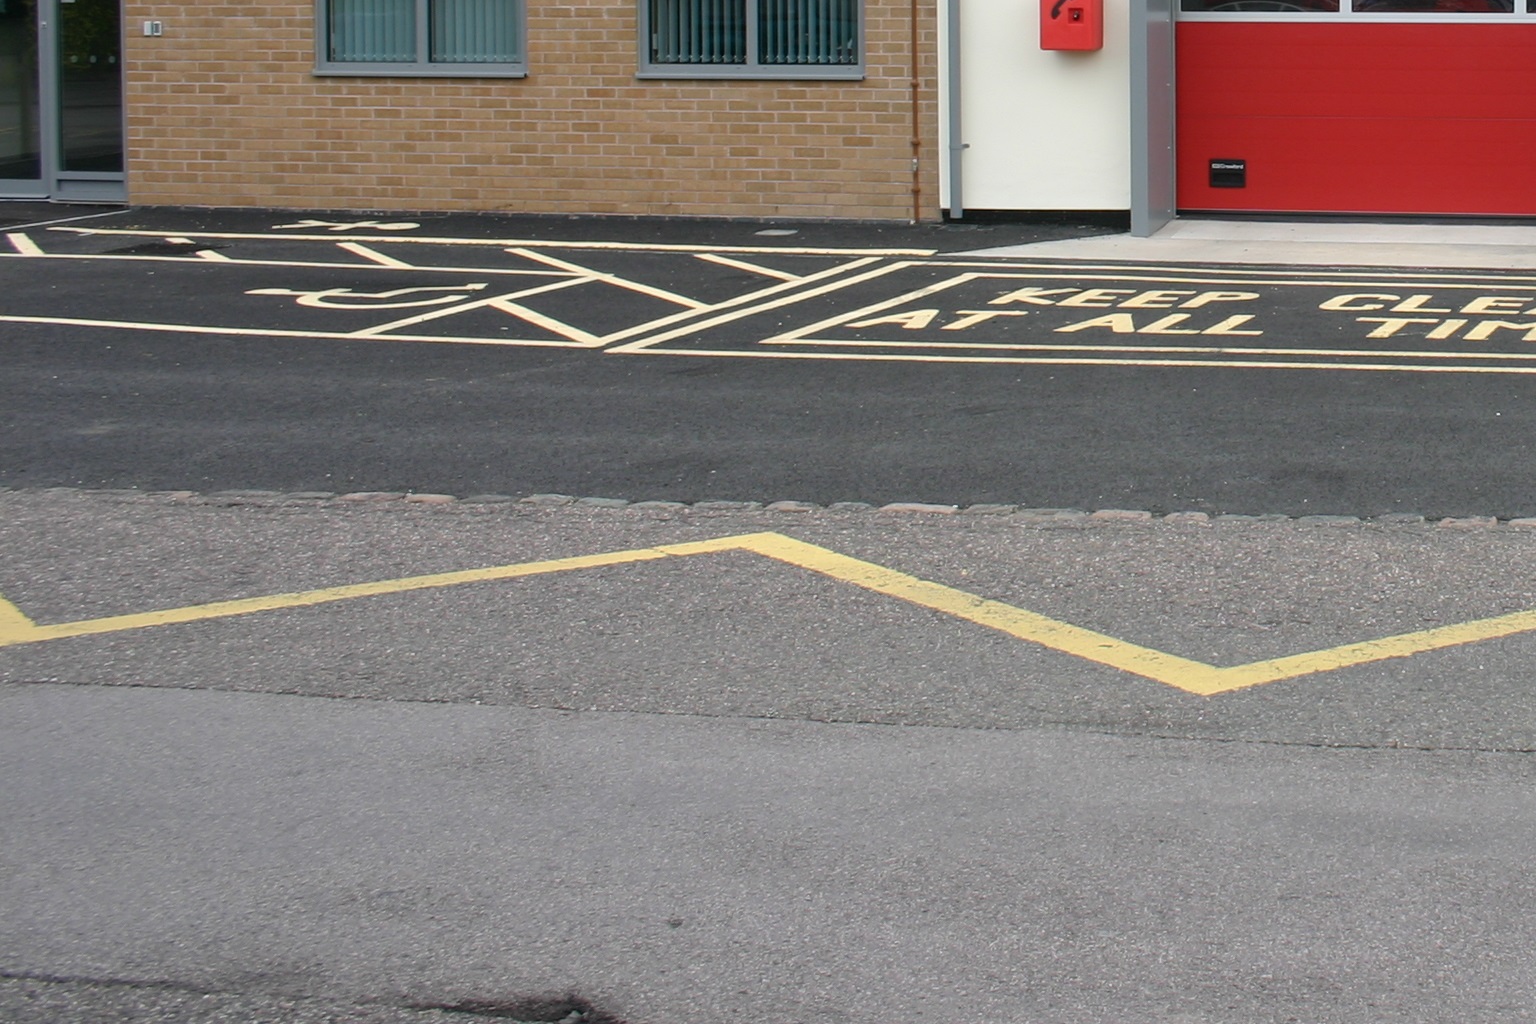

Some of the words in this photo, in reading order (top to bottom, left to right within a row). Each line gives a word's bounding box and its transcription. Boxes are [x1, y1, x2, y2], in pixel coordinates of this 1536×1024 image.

[987, 287, 1260, 309] KEEP
[844, 309, 1029, 330] AT
[1053, 313, 1264, 336] ALL
